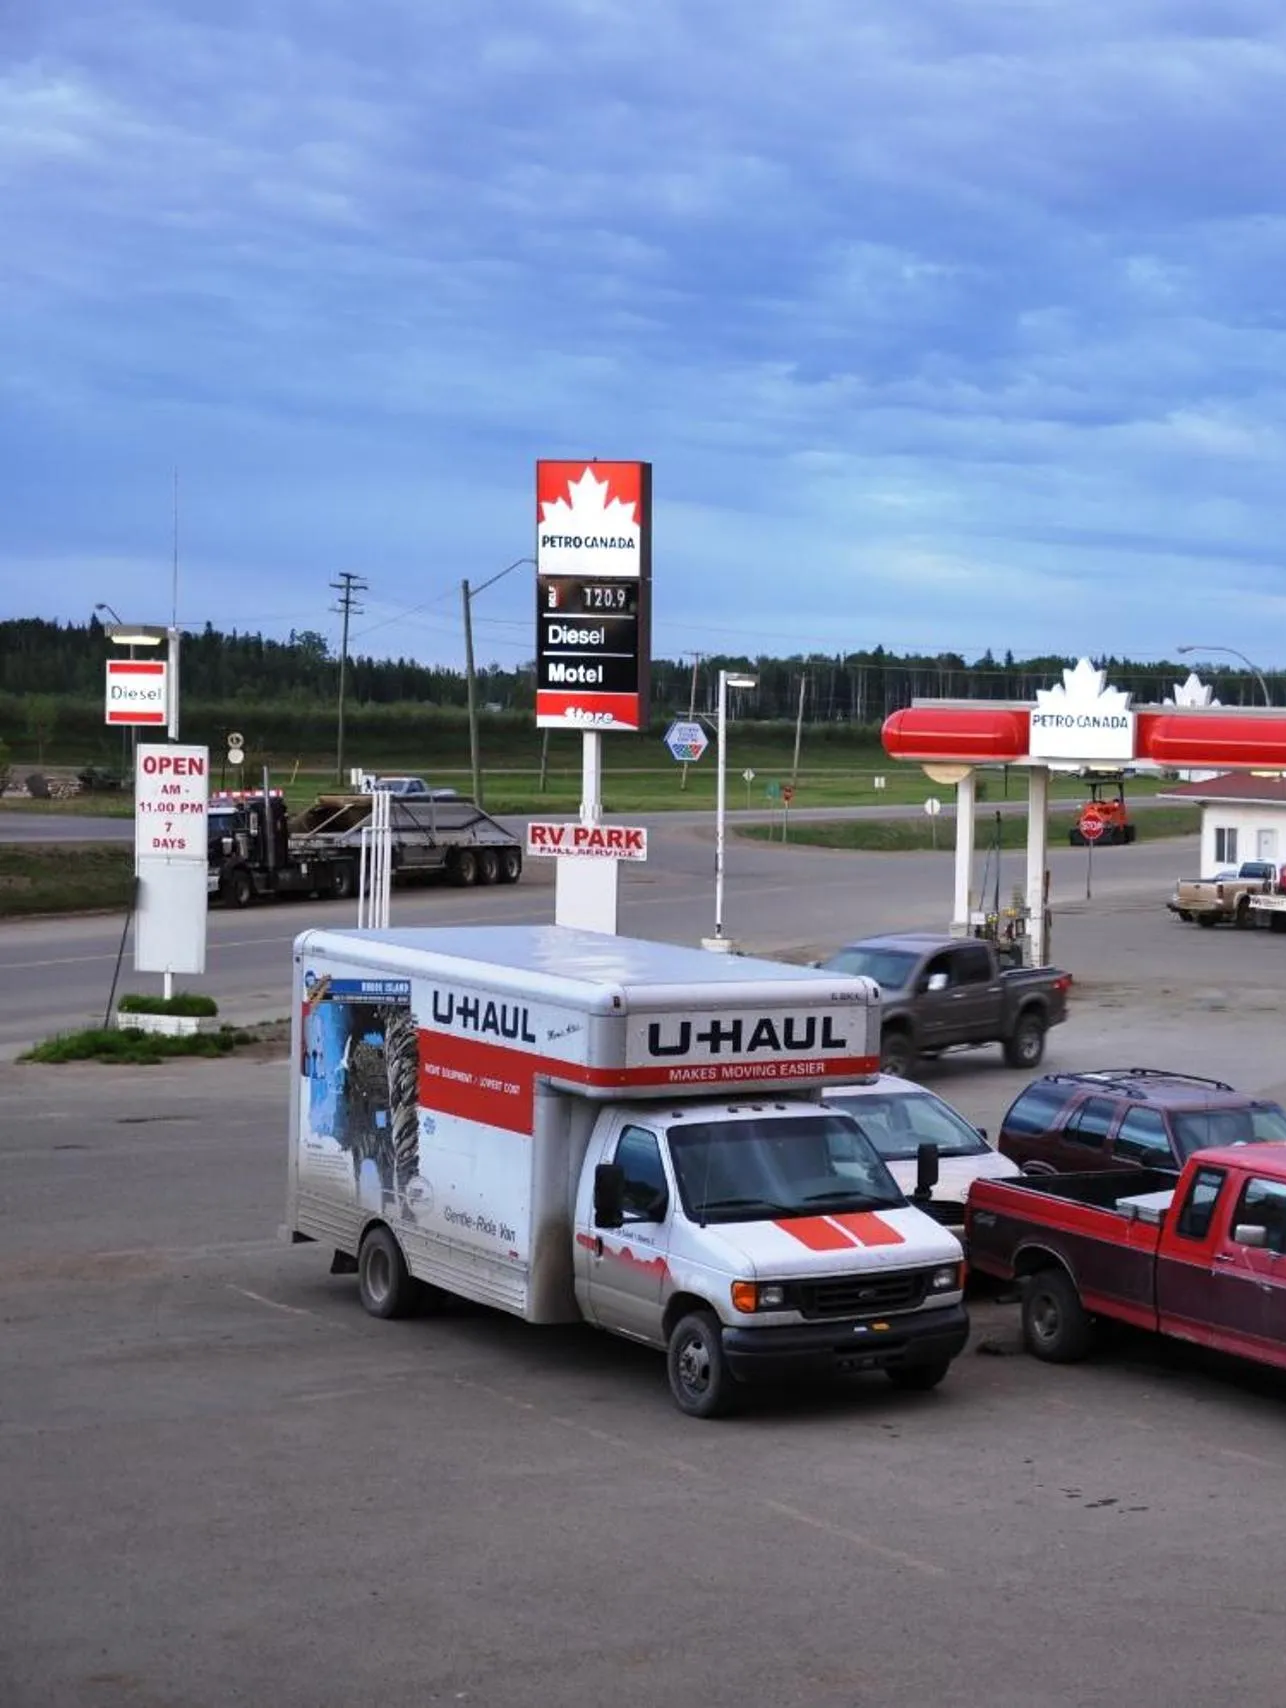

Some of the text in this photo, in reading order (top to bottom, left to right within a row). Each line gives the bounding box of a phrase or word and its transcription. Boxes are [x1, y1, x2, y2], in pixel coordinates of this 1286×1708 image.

[583, 588, 626, 607] 120.9
[548, 625, 605, 645] Diesel
[548, 663, 603, 683] Motel
[110, 685, 162, 701] Diesel
[564, 706, 614, 725] Store
[143, 756, 204, 776] OPEN
[161, 784, 181, 795] AM
[139, 802, 203, 814] 11.00 PM
[165, 822, 172, 832] 7
[152, 838, 186, 850] DAYS
[531, 825, 643, 849] RV PARK
[432, 990, 536, 1043] U-HAUL
[648, 1016, 847, 1056] U-HAUL
[669, 1062, 825, 1081] MAKES MOVING EASIER
